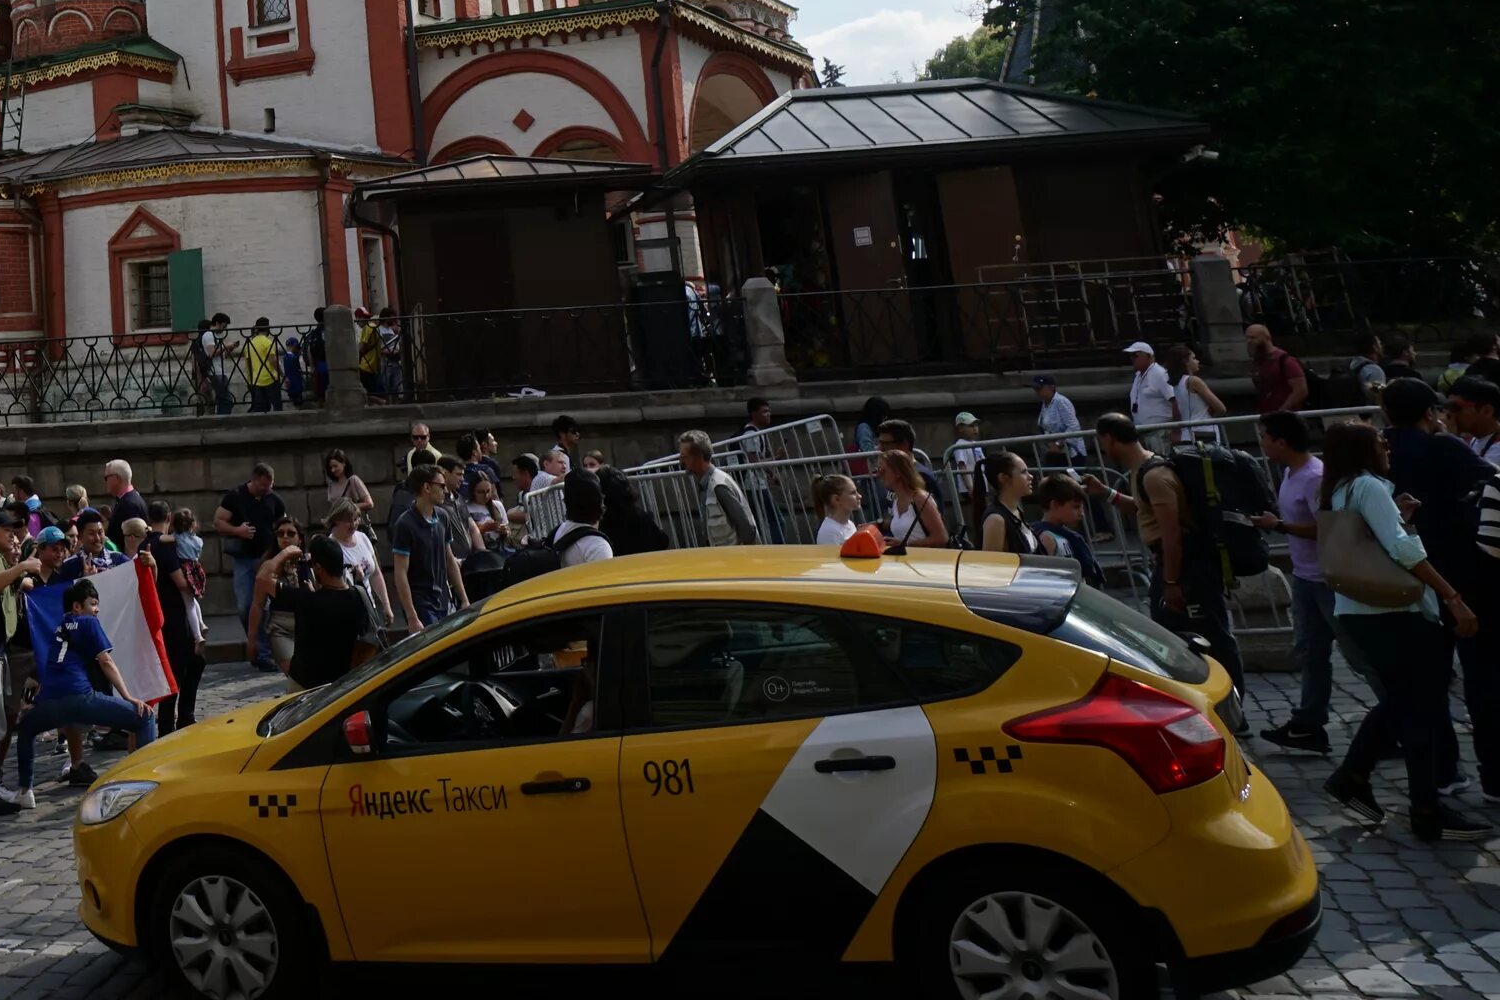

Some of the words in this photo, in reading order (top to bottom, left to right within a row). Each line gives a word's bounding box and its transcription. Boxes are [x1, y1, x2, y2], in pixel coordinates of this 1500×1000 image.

[643, 758, 694, 797] 981
[349, 784, 434, 820] Яндекс
[437, 778, 508, 813] Такси
